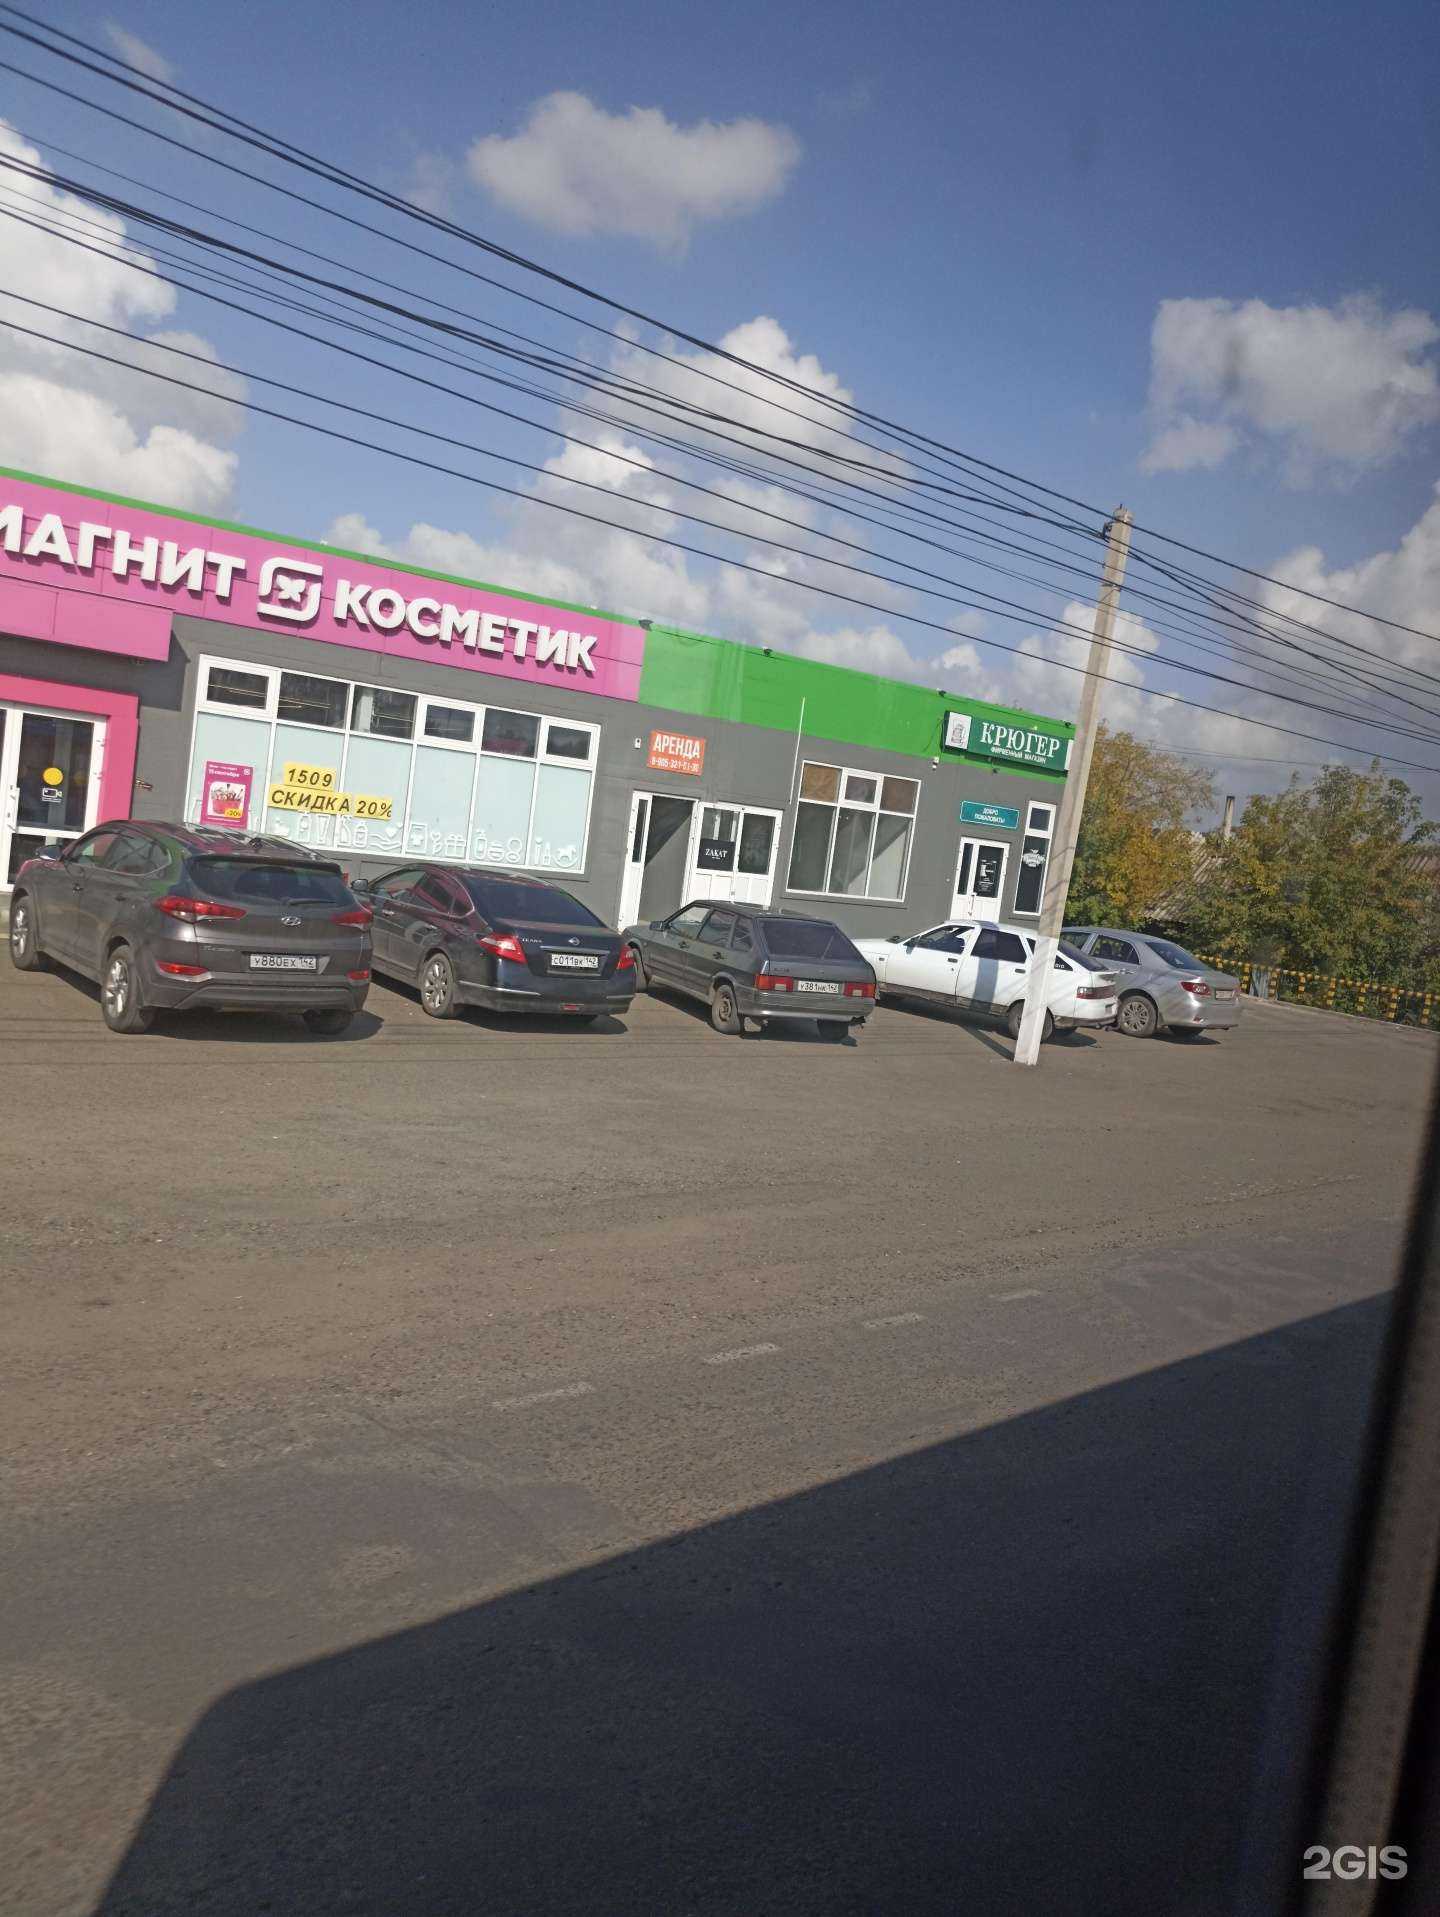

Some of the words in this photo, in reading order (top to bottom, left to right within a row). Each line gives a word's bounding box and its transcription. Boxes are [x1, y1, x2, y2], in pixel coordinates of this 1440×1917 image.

[333, 579, 598, 673] КОСМЕТИК
[652, 733, 701, 760] АРЕНДА
[979, 721, 1061, 759] КРЮГЕР
[288, 768, 333, 788] 1509
[271, 789, 350, 813] СКИДКА
[356, 799, 392, 818] 20%
